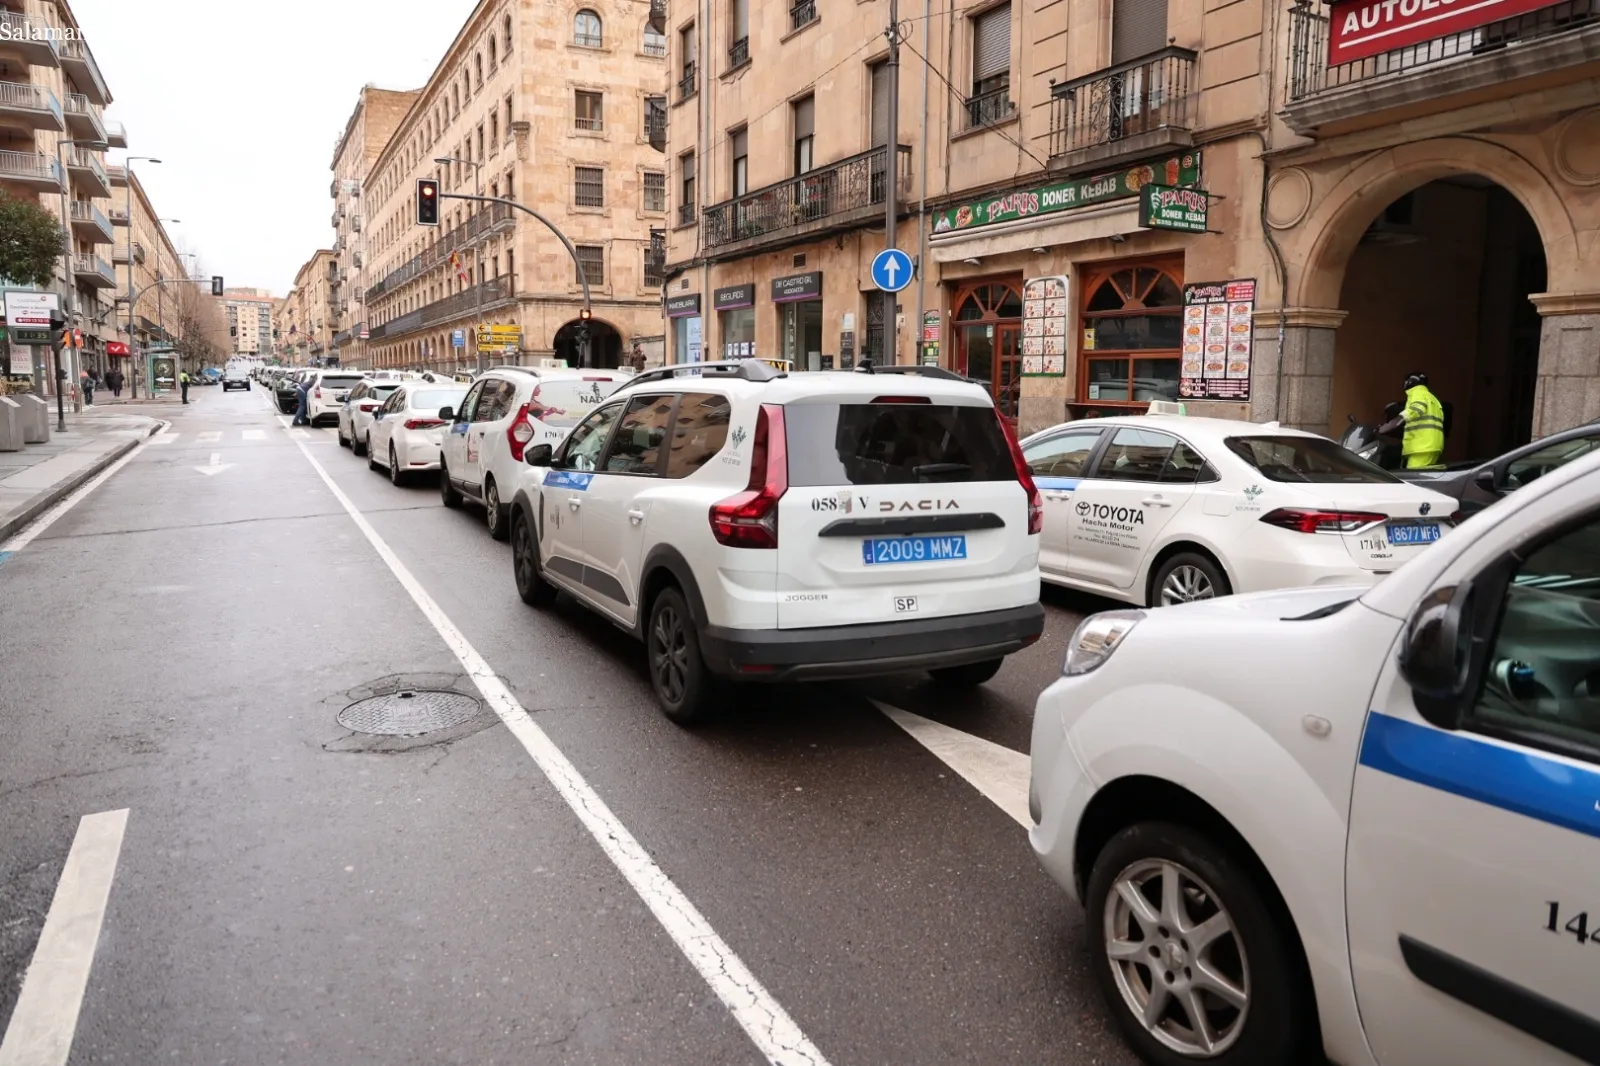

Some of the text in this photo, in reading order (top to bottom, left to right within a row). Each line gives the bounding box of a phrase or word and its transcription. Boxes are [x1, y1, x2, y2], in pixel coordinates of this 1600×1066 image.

[986, 178, 1117, 223] PARIS DONER KEBAB
[1160, 190, 1207, 213] PARIS
[1161, 209, 1206, 222] DONER KEBAB
[720, 290, 744, 301] SEGUROS
[811, 496, 870, 511] 058 V
[879, 499, 960, 512] DACIA
[1093, 503, 1144, 524] TOYOTA
[1082, 518, 1134, 531] Hacha Motor
[1394, 526, 1439, 541] 8677 MFG
[877, 538, 963, 561] 2009 MMZ
[785, 594, 828, 602] JOGGER
[897, 598, 915, 610] SP
